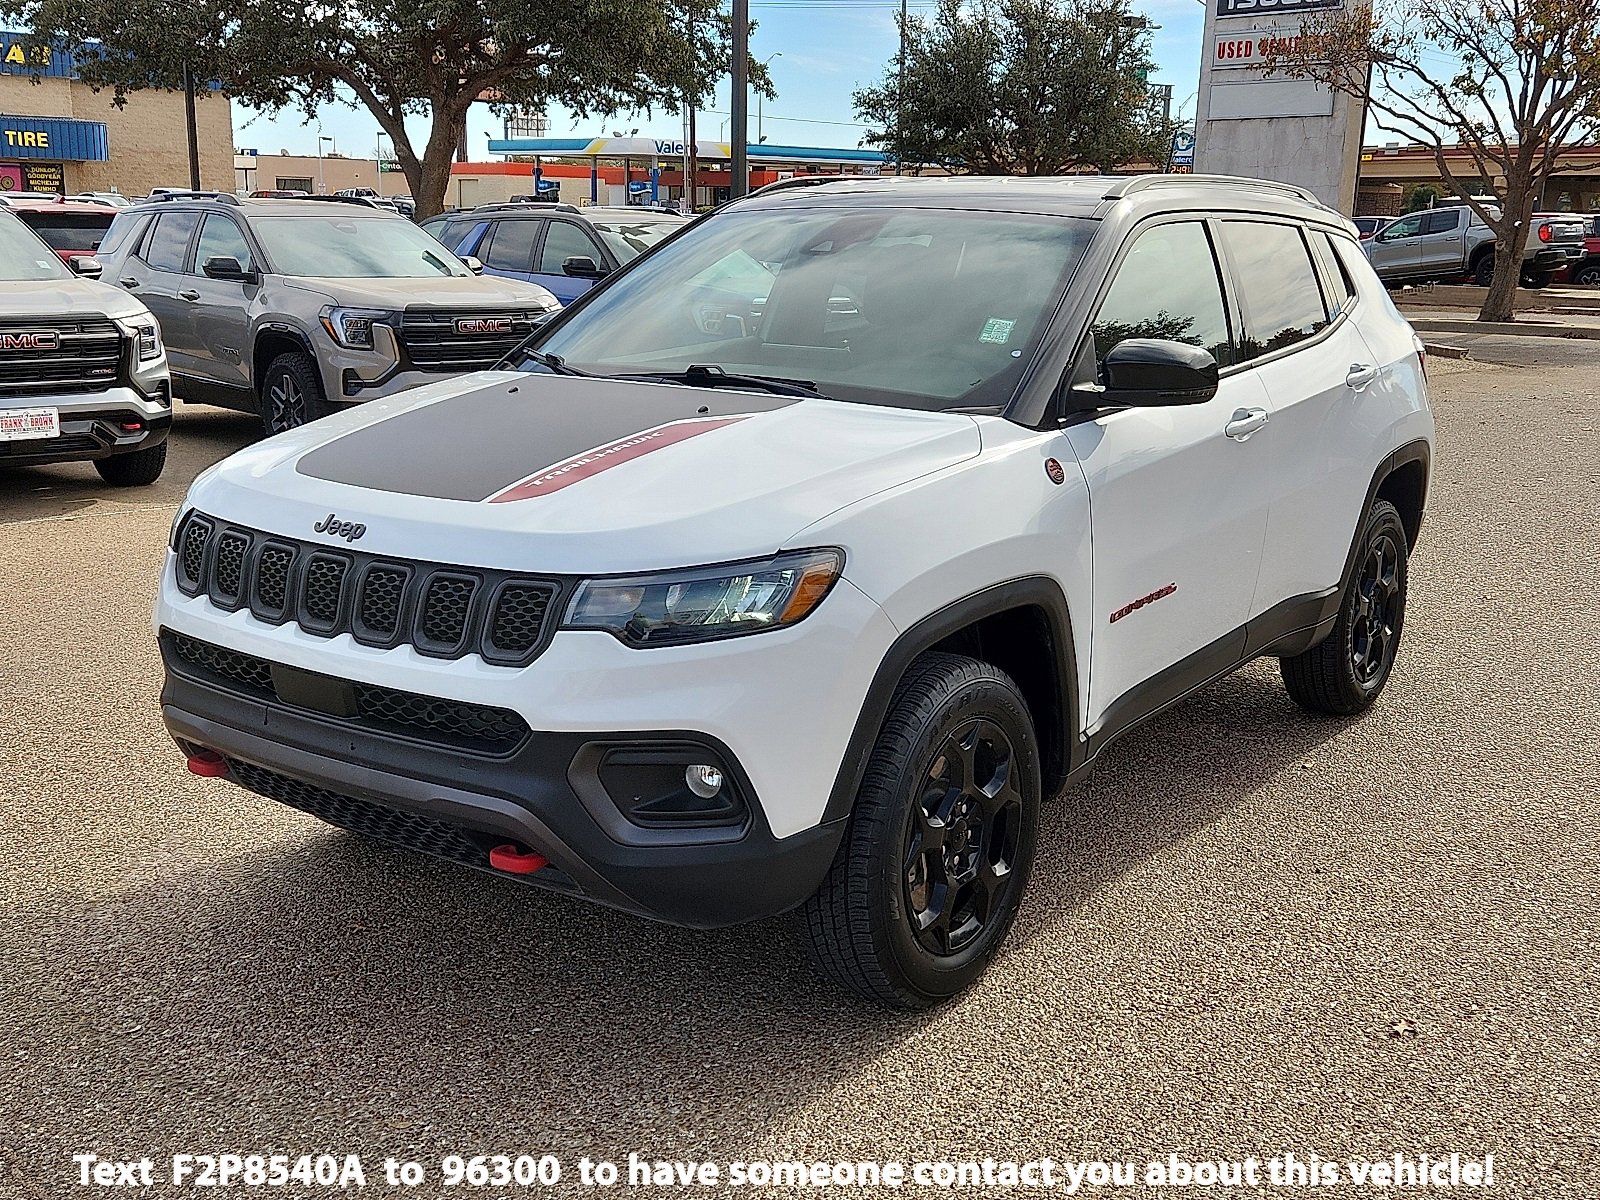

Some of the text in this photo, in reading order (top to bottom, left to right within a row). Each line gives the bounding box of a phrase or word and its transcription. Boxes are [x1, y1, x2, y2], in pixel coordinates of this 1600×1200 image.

[1217, 39, 1253, 60] USED
[4, 130, 49, 148] TIRE
[458, 320, 512, 333] GMC
[0, 333, 56, 349] MC
[30, 416, 54, 427] BROWN
[524, 431, 664, 488] TRAILHAWK
[313, 513, 367, 543] Jeep
